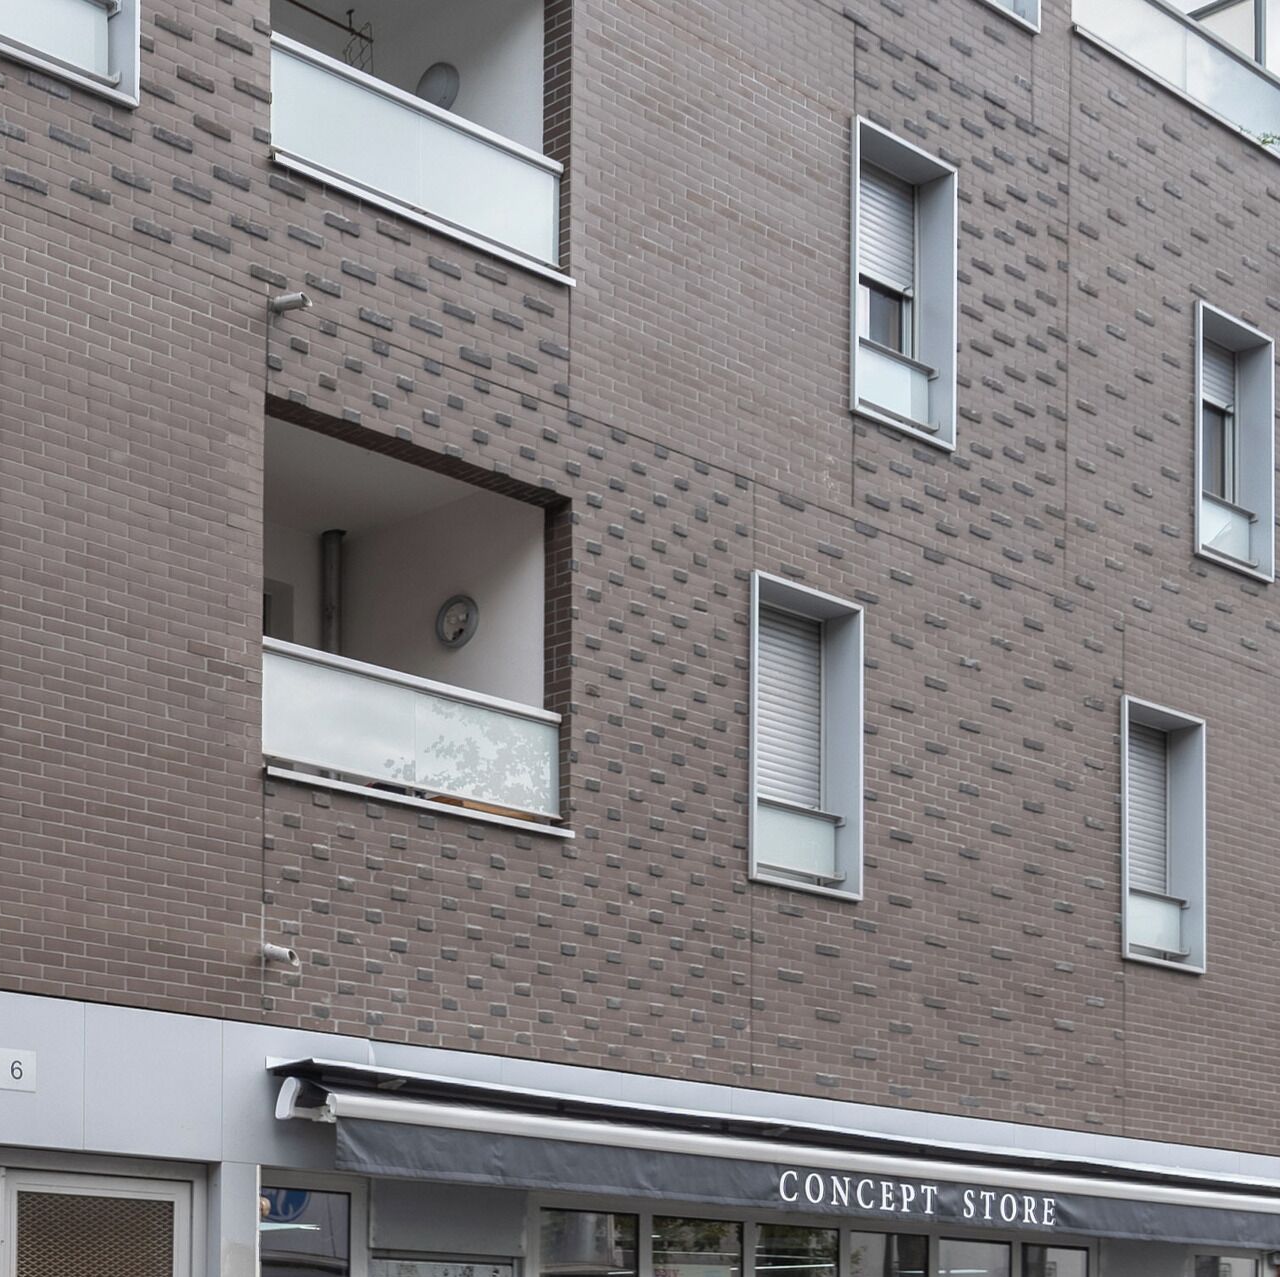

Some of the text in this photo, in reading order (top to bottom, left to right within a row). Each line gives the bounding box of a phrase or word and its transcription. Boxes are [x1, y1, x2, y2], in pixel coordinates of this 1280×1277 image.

[10, 1060, 23, 1080] 6
[779, 1170, 1057, 1226] CONCEPT STORE
